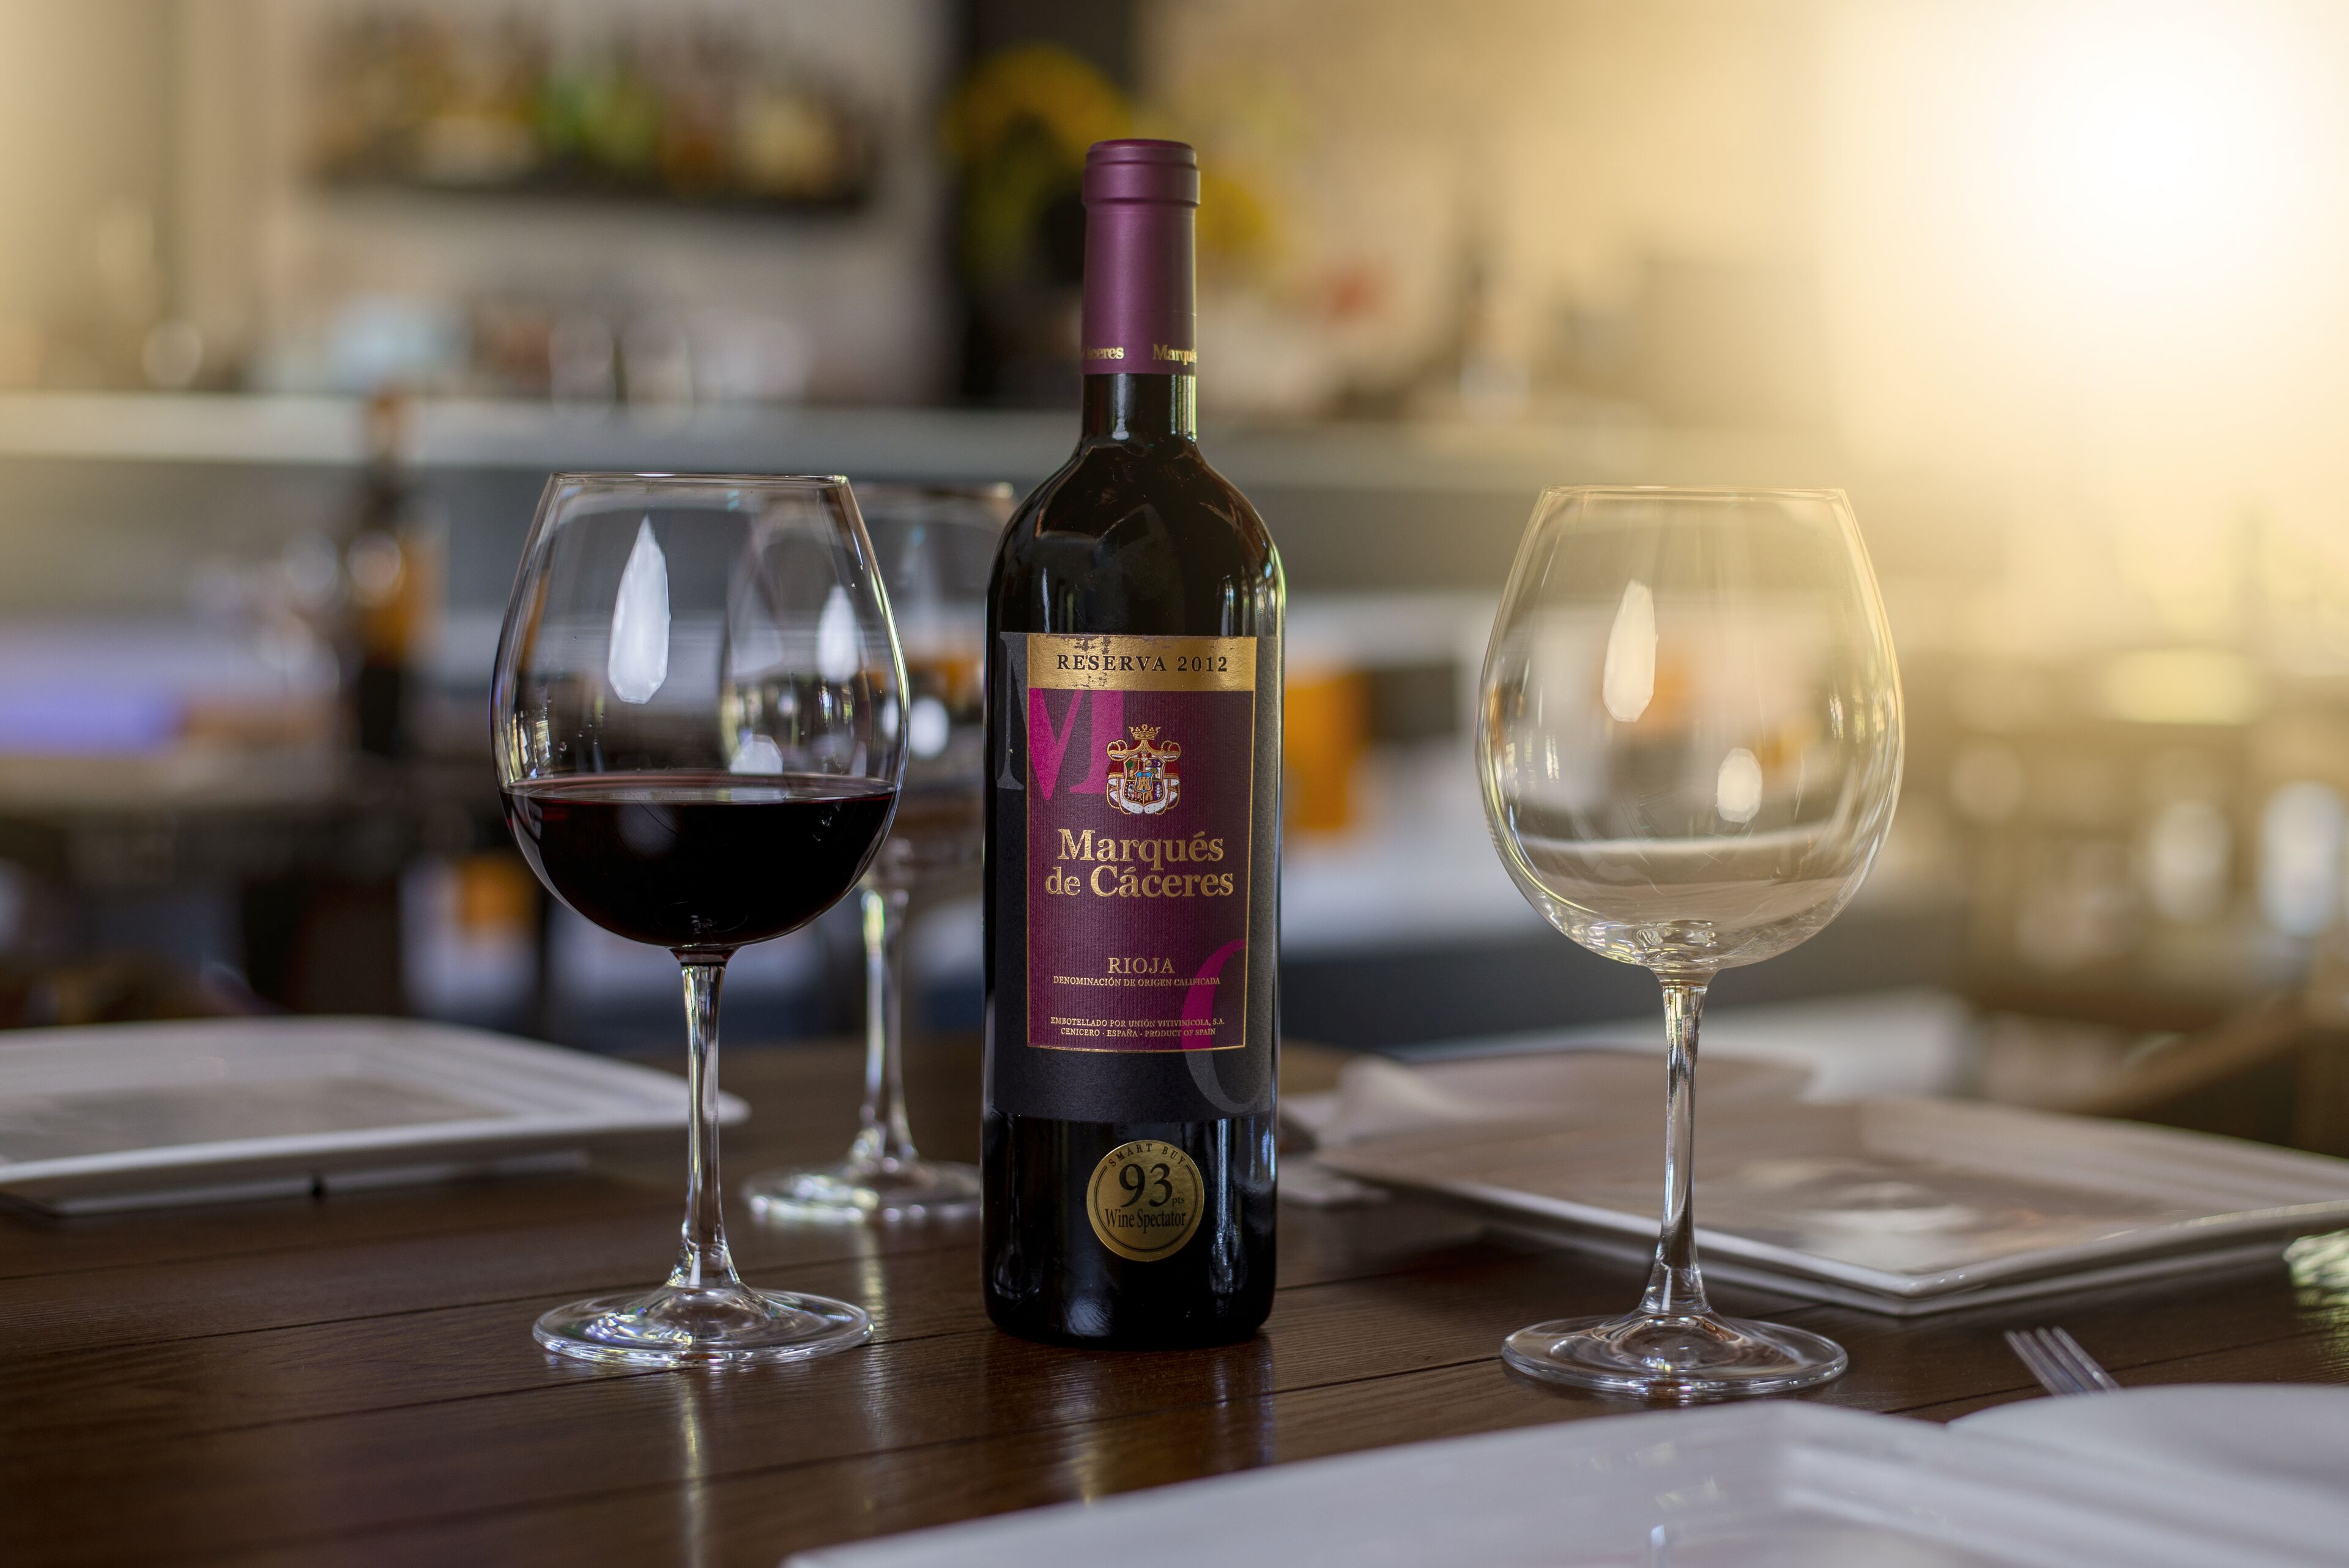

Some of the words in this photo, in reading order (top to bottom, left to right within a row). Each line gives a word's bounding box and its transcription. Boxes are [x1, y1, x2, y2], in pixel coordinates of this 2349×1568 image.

[1085, 347, 1124, 360] ceres
[1056, 655, 1167, 672] RESERVA
[1177, 656, 1228, 672] 2012
[1057, 828, 1224, 871] Marqués
[1045, 866, 1081, 896] de
[1090, 865, 1234, 897] Cáceres
[1108, 957, 1176, 974] RIOJA
[1053, 976, 1121, 986] DENOMINACIÓN
[1174, 977, 1221, 986] CALIFICADA
[1050, 1017, 1108, 1027] EMBOTELLADO
[1129, 1019, 1156, 1027] UNIÓN
[1061, 1027, 1100, 1036] CENICERO
[1107, 1028, 1138, 1037] ESPAÑA
[1108, 1143, 1153, 1167] SMART
[1161, 1145, 1186, 1165] BUY
[1119, 1163, 1173, 1208] 93
[1171, 1195, 1185, 1207] pts
[1105, 1208, 1135, 1228] Wine
[1137, 1208, 1186, 1233] Spectator
